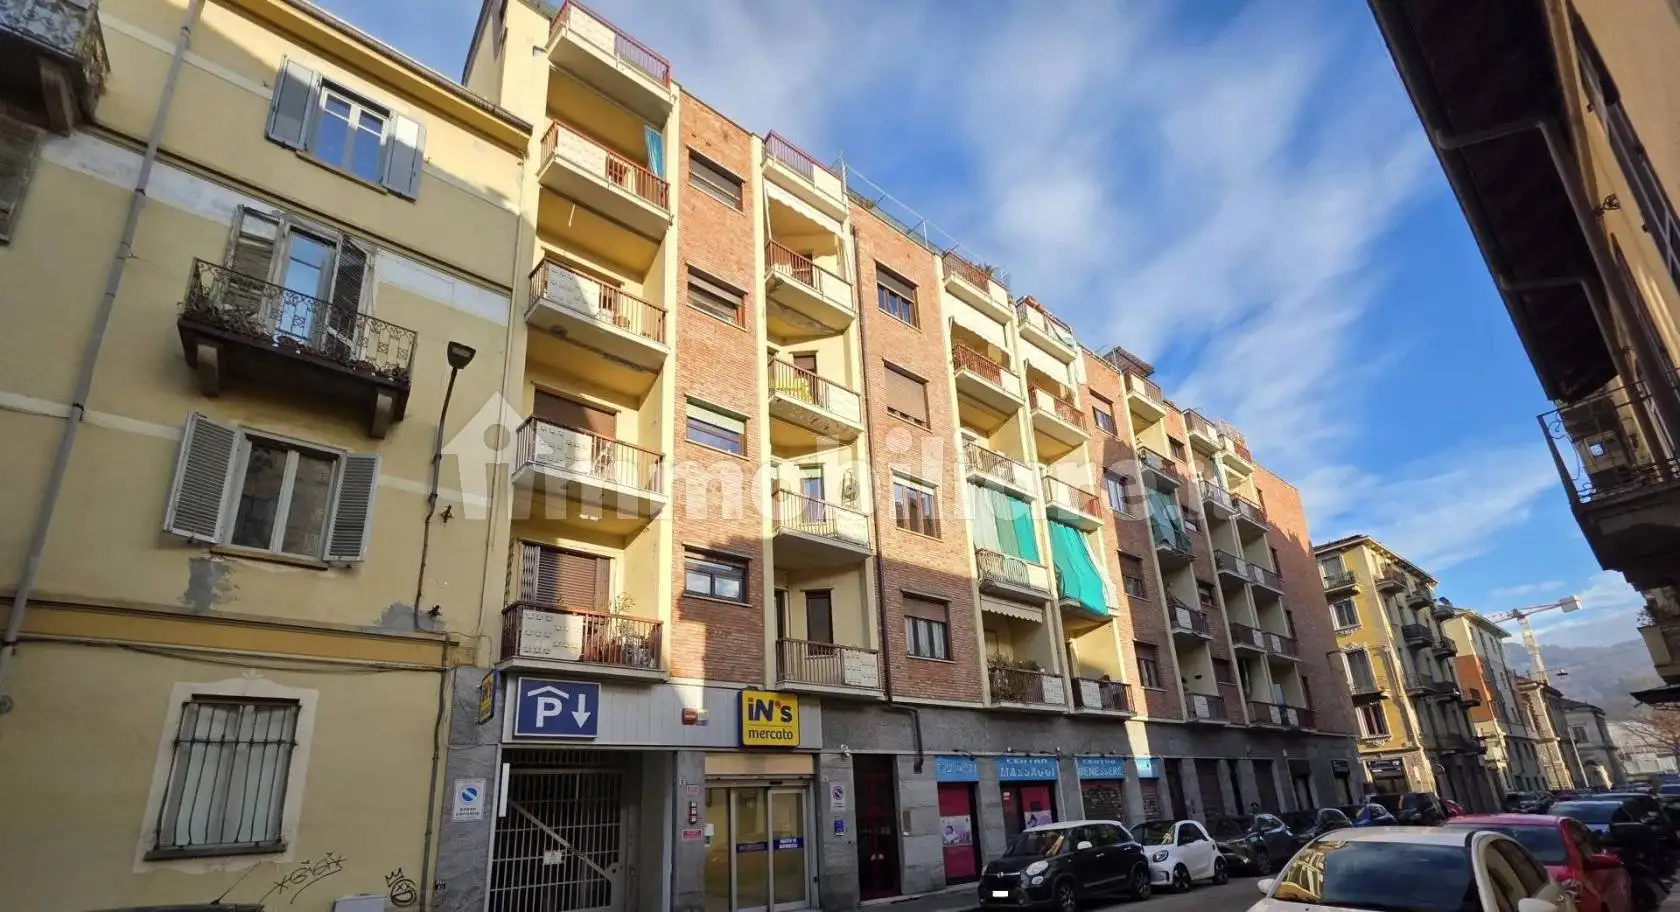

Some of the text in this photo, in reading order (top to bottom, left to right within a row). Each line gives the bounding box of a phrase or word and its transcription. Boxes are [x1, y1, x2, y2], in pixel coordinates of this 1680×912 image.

[536, 697, 562, 727] P
[748, 697, 793, 722] iN's
[748, 729, 793, 740] mercato
[1000, 767, 1055, 778] MASSAGGI
